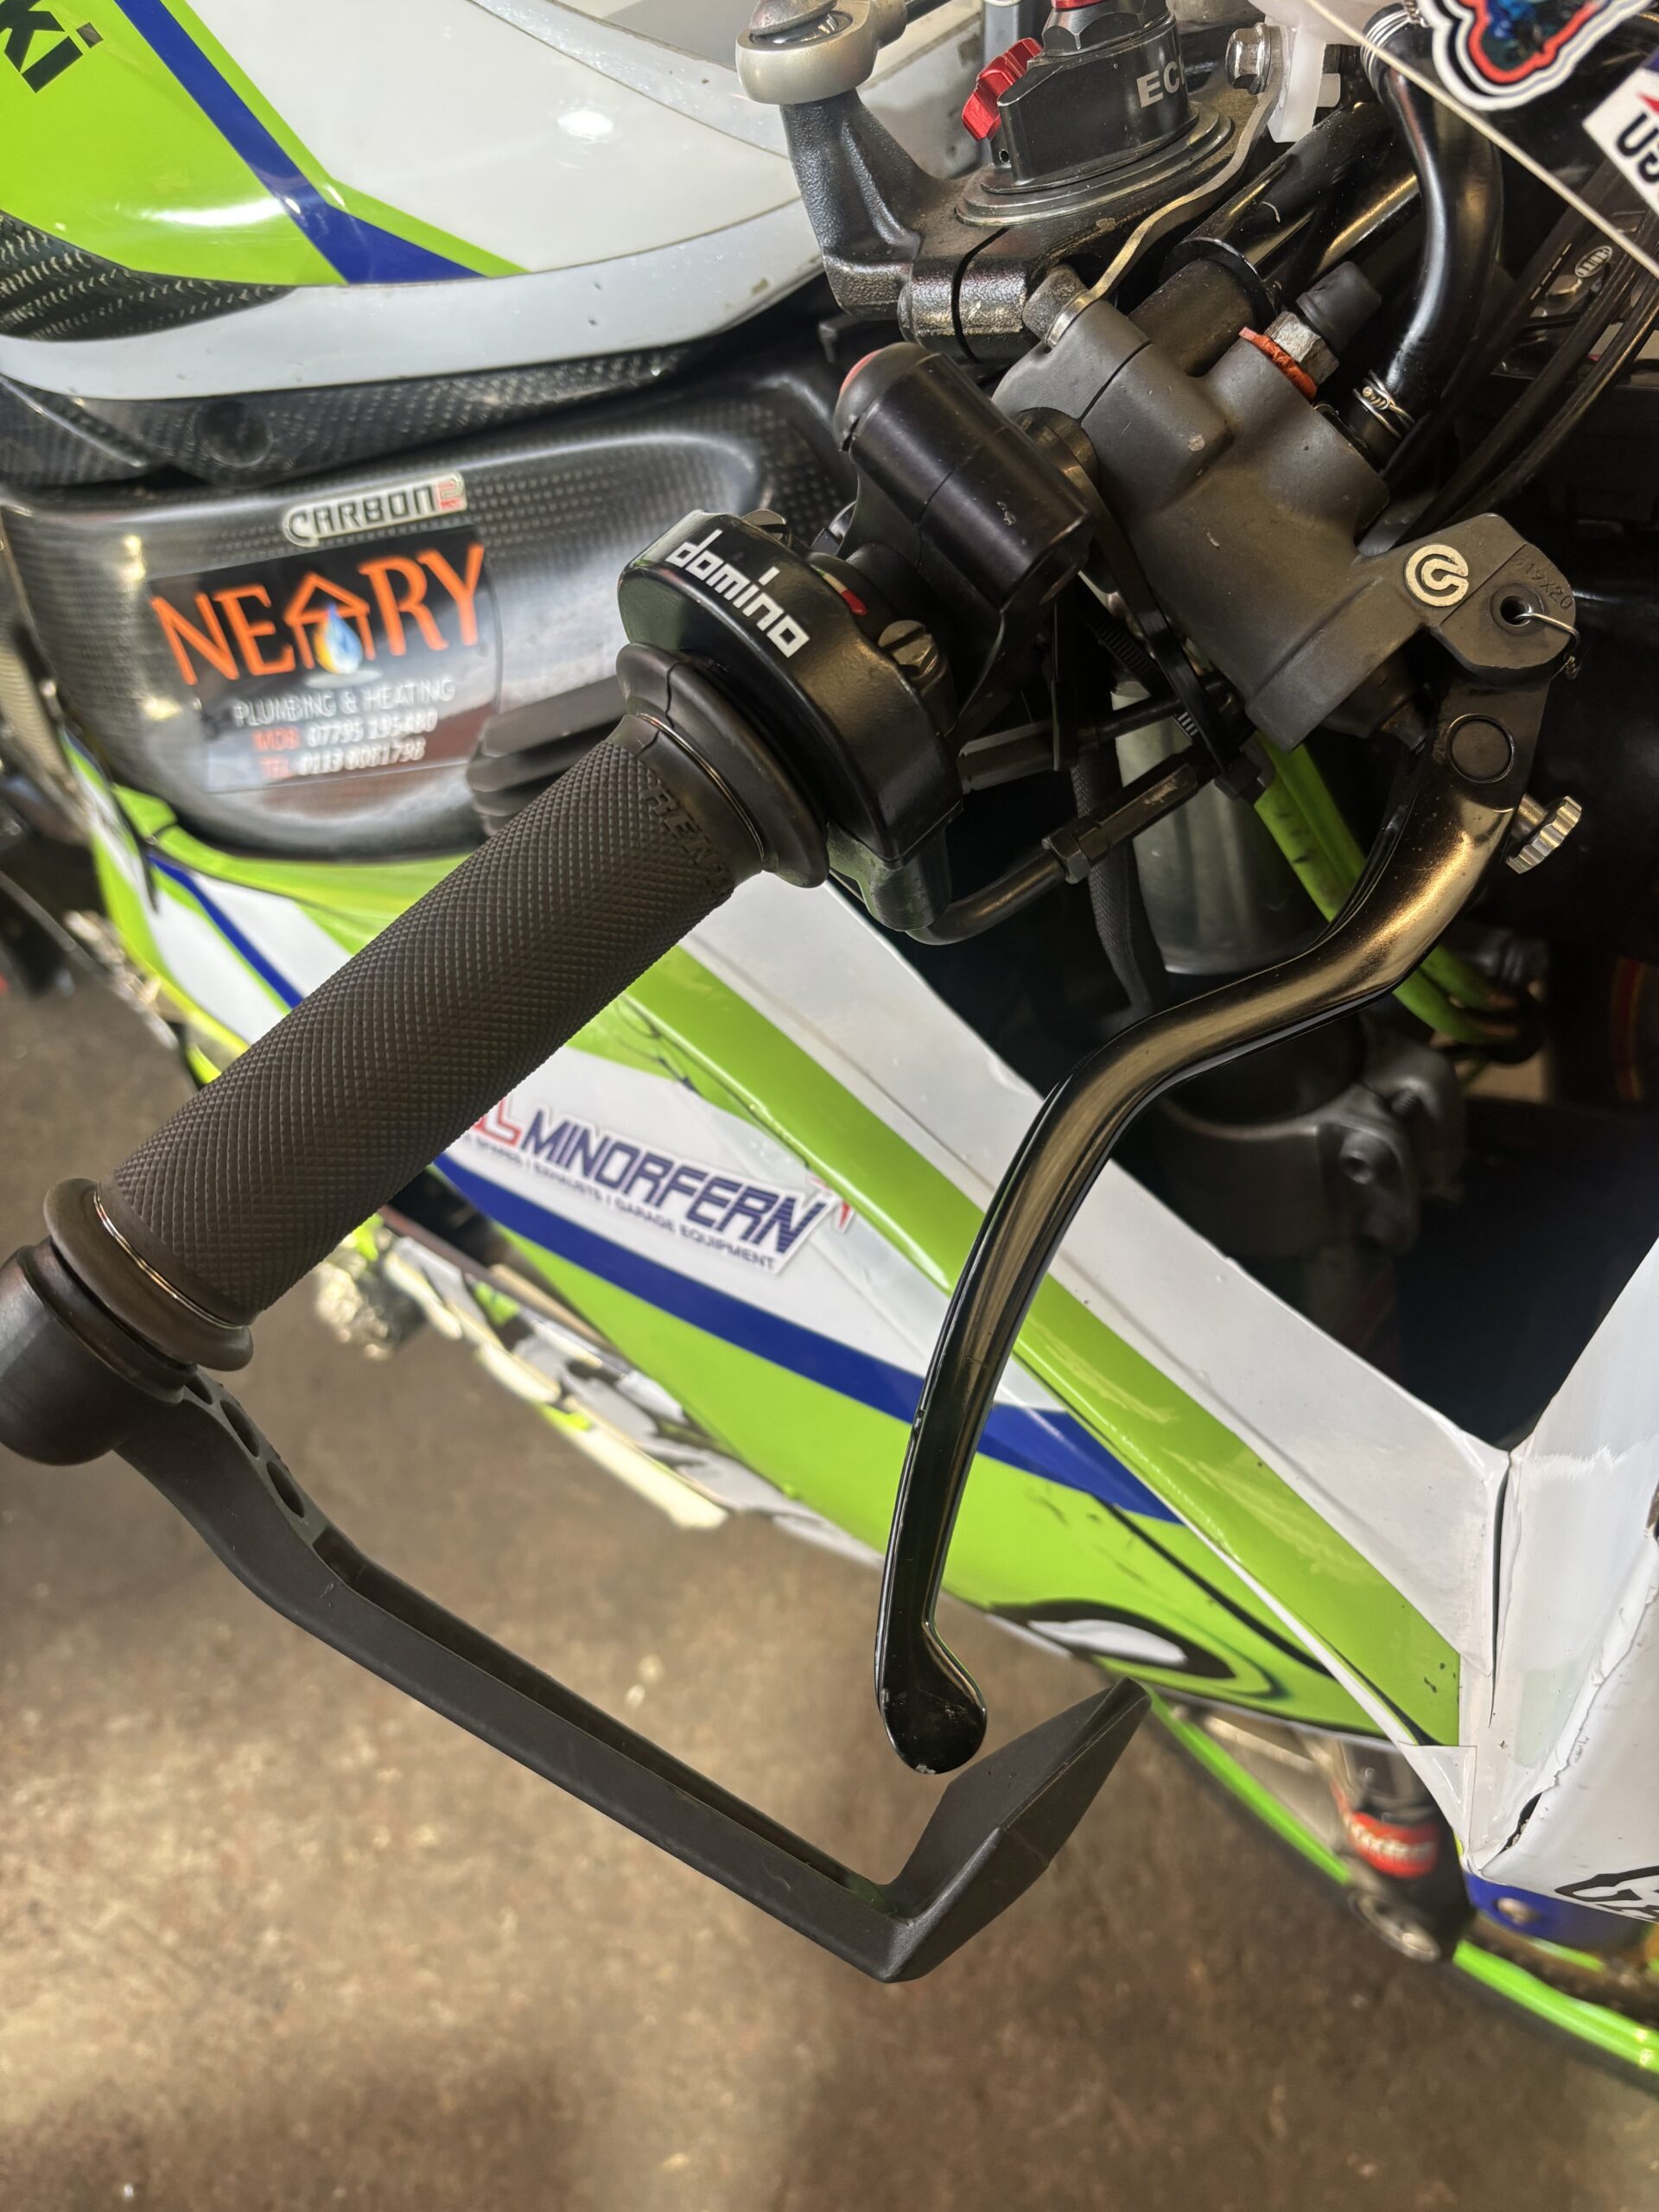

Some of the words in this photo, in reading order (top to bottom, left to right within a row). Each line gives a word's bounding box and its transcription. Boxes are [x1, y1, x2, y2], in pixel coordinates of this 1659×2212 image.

[1137, 60, 1185, 108] EC
[151, 542, 485, 685] NEARY
[665, 529, 810, 658] domino
[232, 691, 337, 728] PLUMBING
[338, 690, 359, 715] &
[364, 677, 456, 710] HEATING
[520, 1109, 827, 1253] MINORFERN
[679, 1224, 774, 1270] EQUIPMENT
